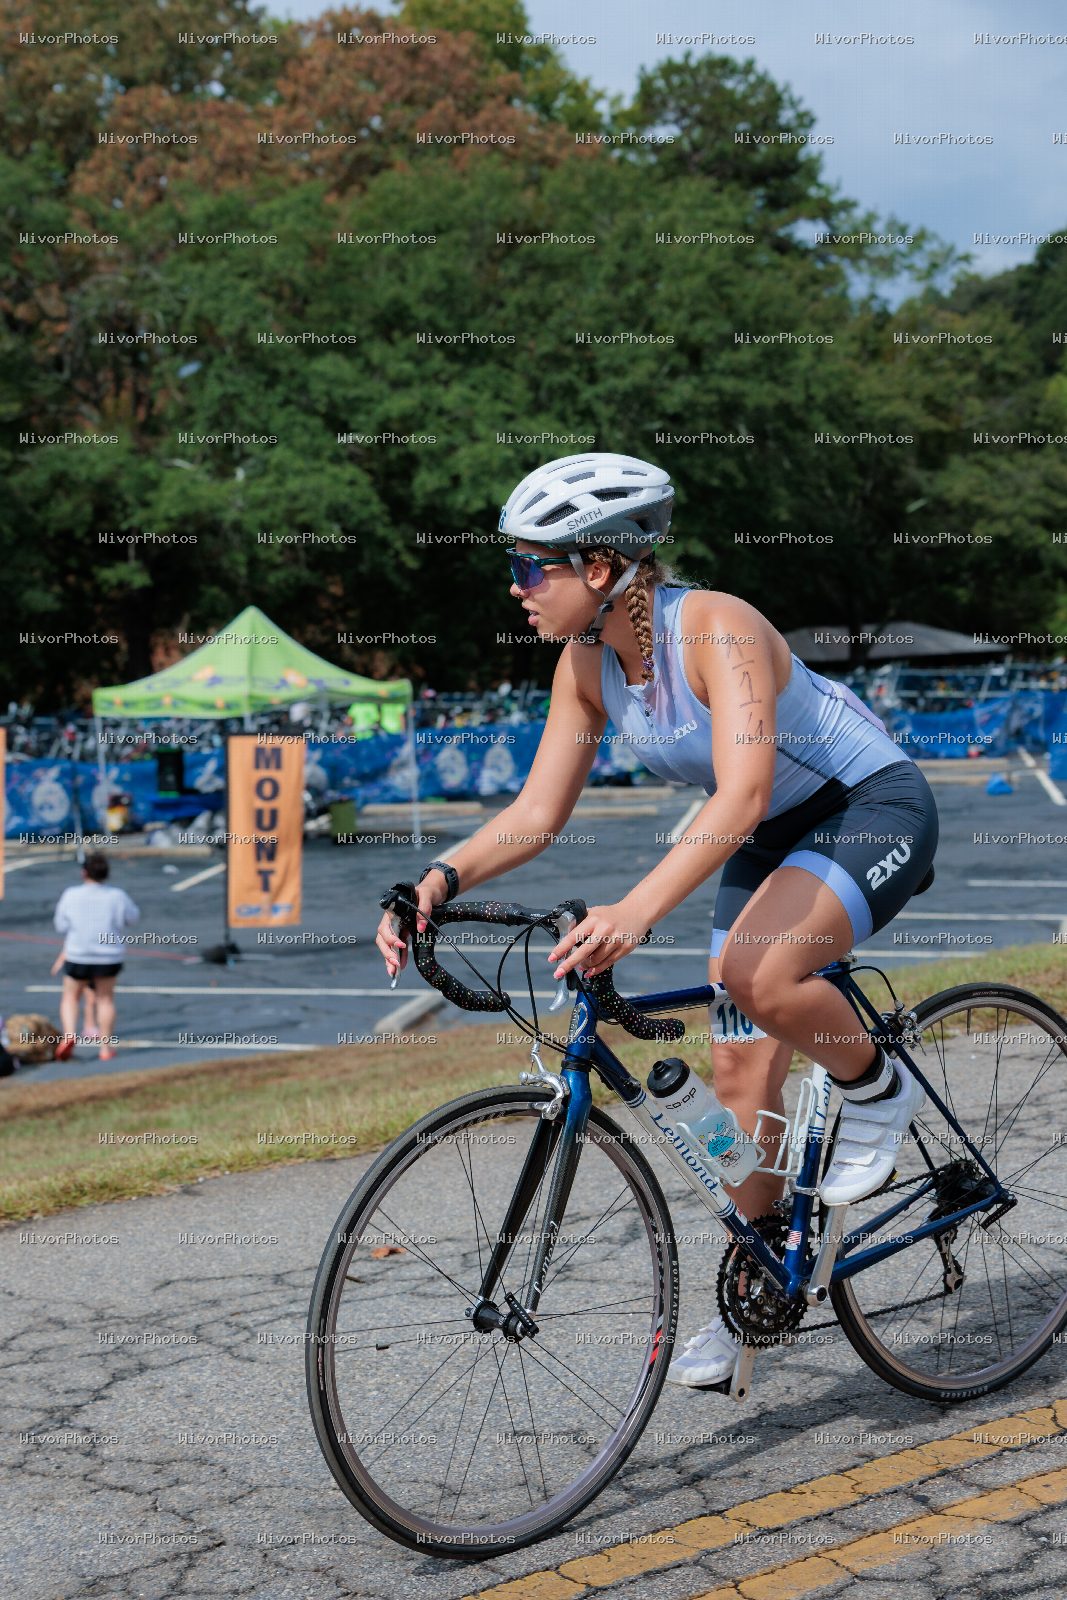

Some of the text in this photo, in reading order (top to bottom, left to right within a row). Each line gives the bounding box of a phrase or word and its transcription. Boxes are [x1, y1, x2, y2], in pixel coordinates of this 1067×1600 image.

[566, 507, 603, 531] SMITH
[673, 719, 698, 740] 2XU
[254, 747, 282, 893] MOUNT
[866, 841, 911, 891] 2XU
[670, 1260, 679, 1334] BONTRAGER
